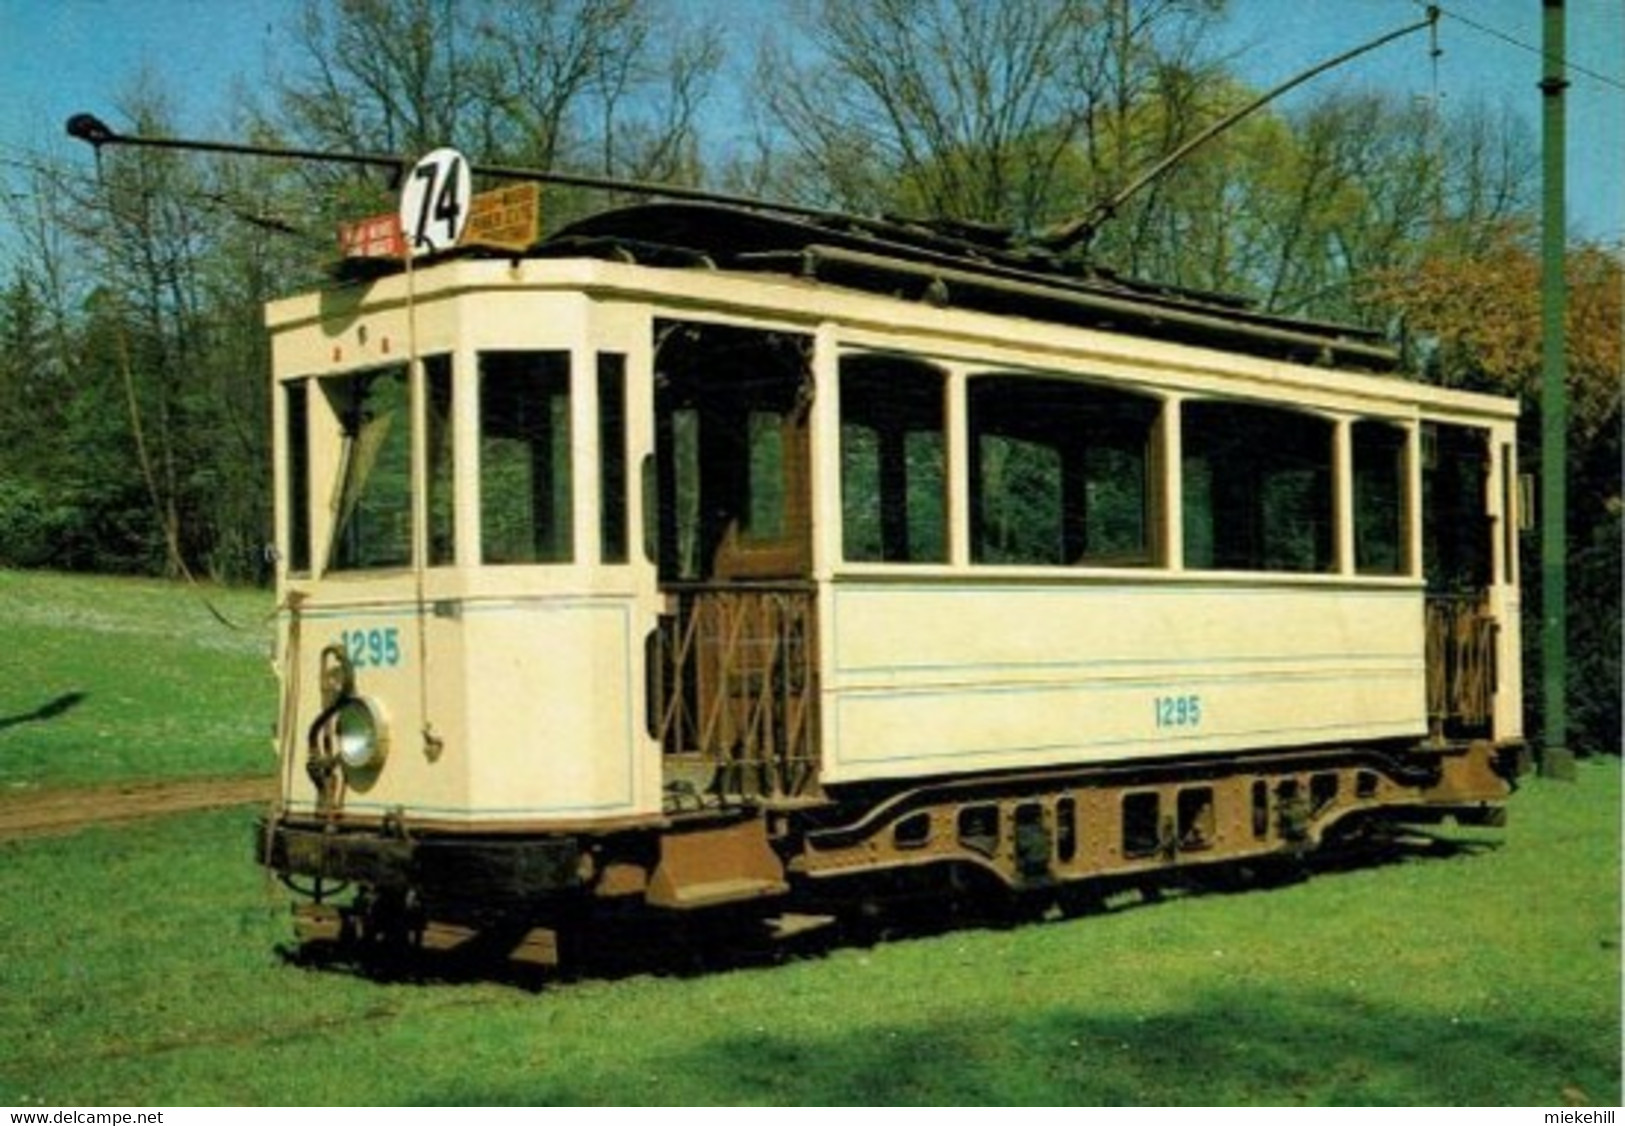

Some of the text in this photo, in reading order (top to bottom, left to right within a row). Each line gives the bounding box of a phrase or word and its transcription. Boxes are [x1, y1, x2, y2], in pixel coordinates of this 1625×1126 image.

[415, 156, 460, 247] 74
[341, 628, 399, 667] 1295
[1154, 695, 1201, 728] 1295
